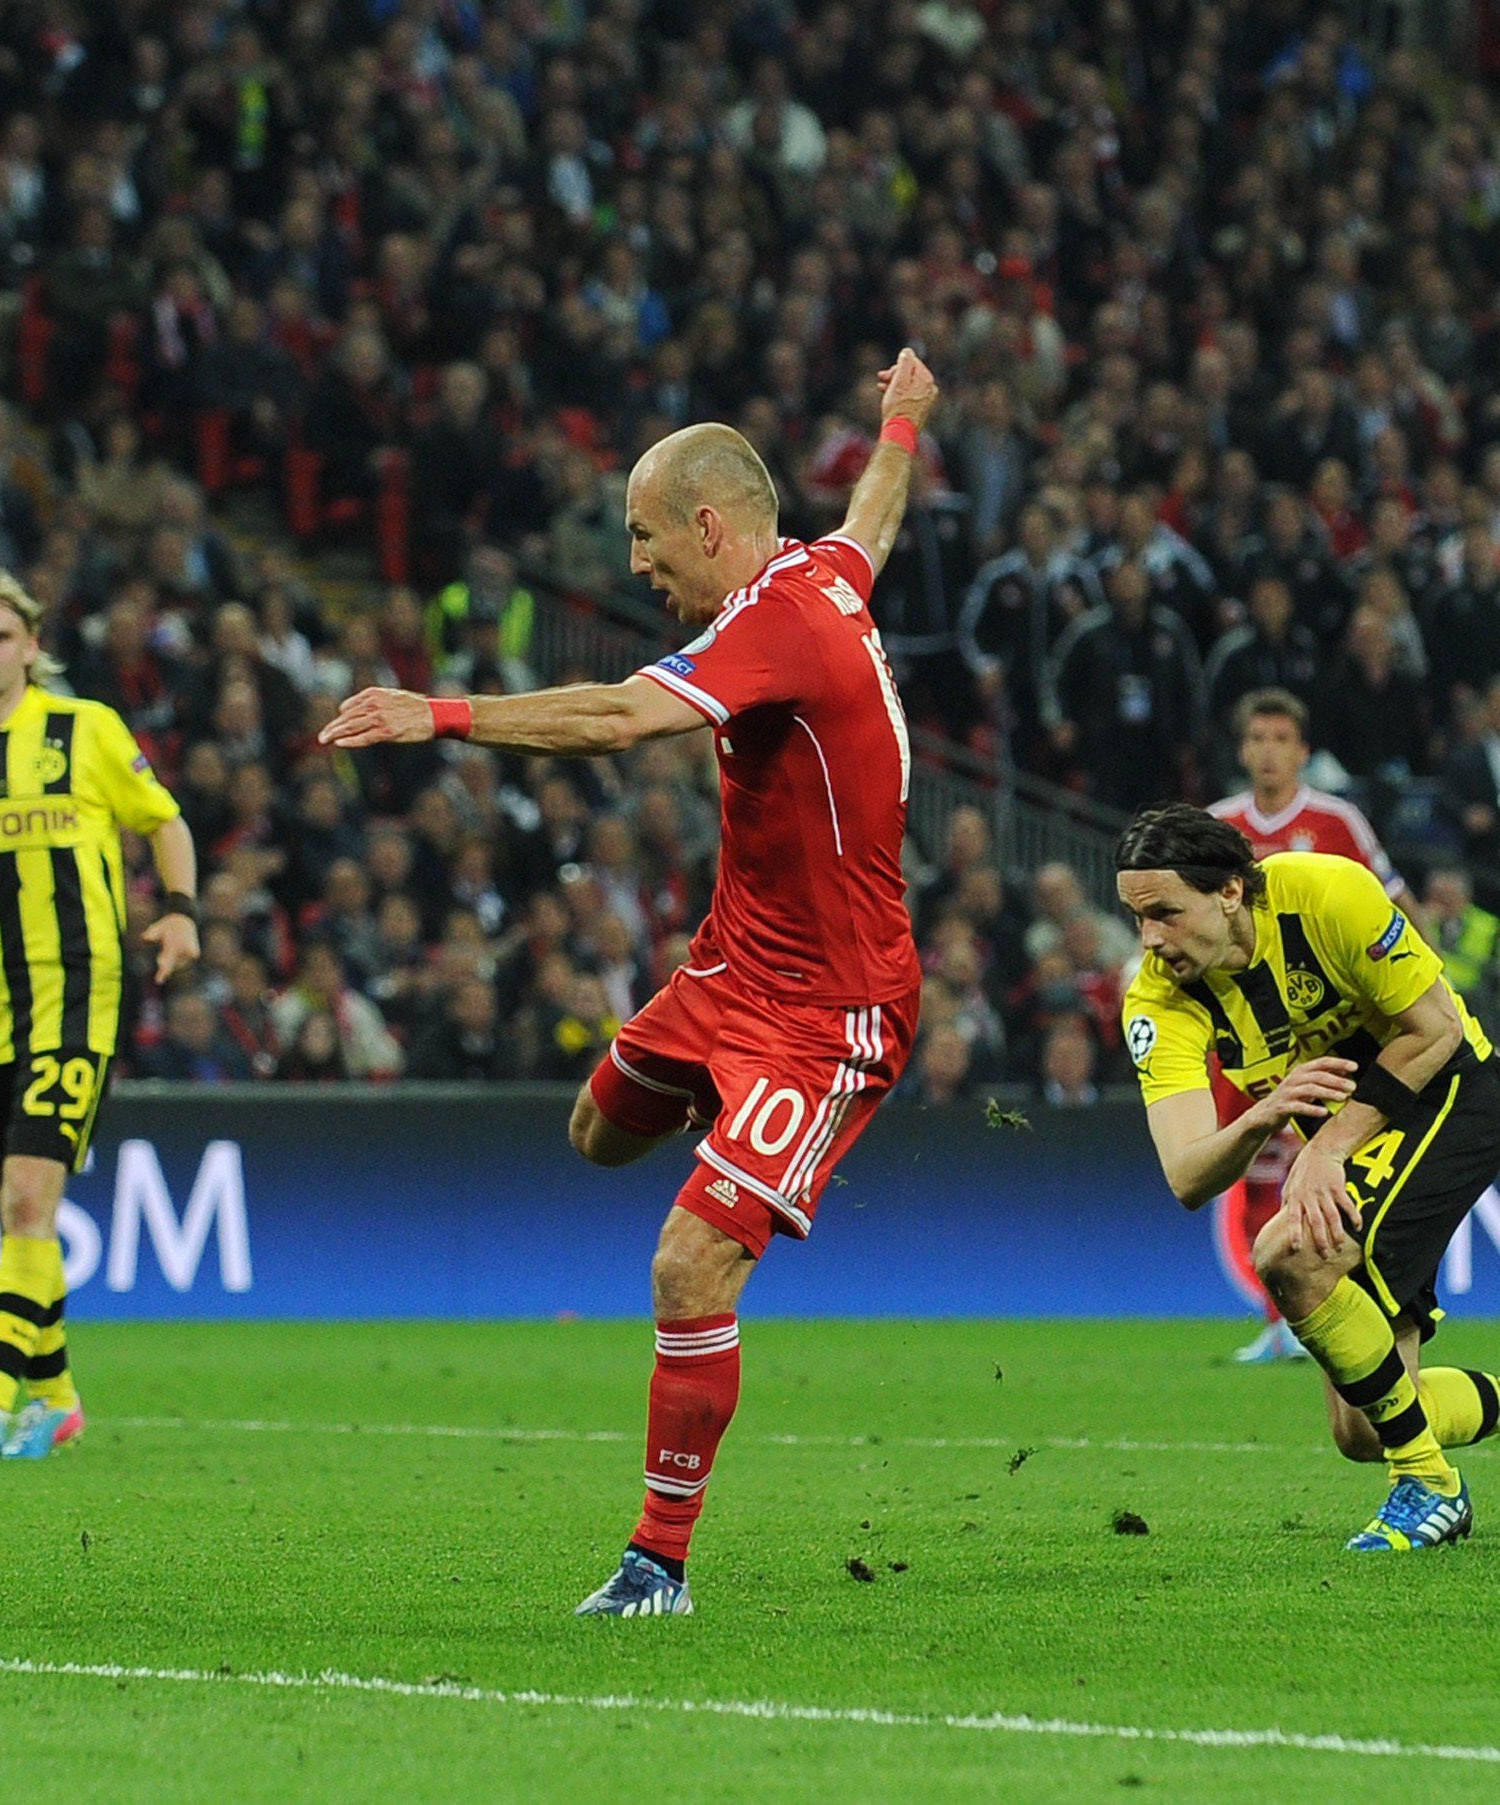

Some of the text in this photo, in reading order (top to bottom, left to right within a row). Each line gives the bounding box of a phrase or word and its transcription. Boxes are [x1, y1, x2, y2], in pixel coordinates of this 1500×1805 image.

[1287, 974, 1318, 1000] BVB
[23, 1056, 95, 1119] 29
[727, 1077, 805, 1156] 10
[1352, 1129, 1405, 1188] 4
[659, 1449, 701, 1470] FCB
